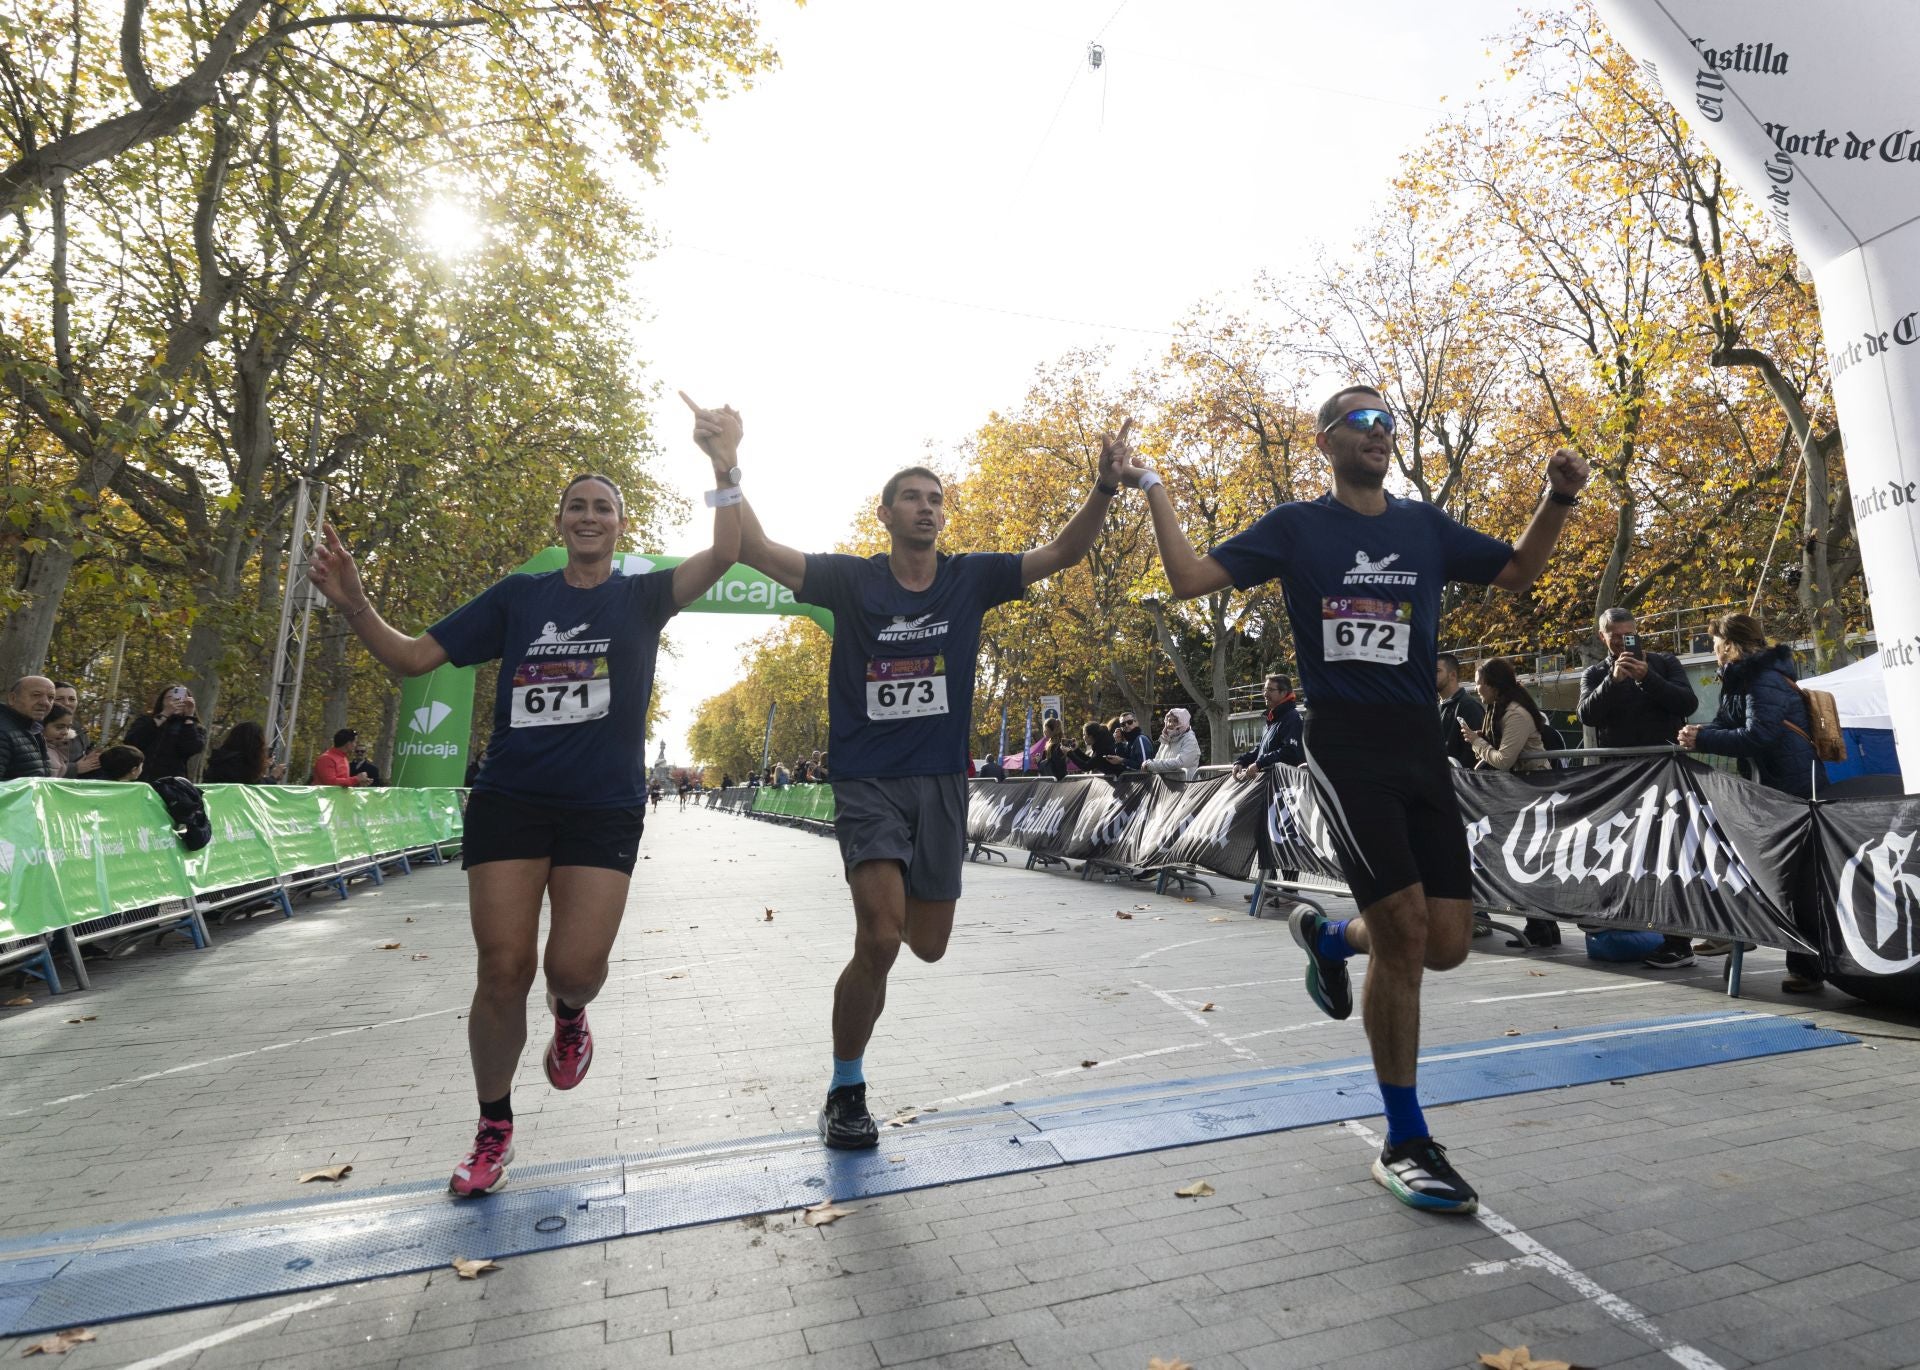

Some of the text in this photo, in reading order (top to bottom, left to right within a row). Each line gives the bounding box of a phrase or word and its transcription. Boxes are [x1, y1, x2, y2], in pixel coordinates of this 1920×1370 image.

[1844, 130, 1876, 161] de
[1863, 331, 1889, 357] de
[1888, 481, 1916, 507] de
[1342, 575, 1417, 585] MICHELIN
[877, 625, 948, 641] MICHELIN
[1336, 622, 1395, 650] 672
[525, 643, 609, 656] MICHELIN
[525, 684, 589, 714] 671
[878, 680, 934, 707] 673
[398, 740, 458, 759] Unicaja
